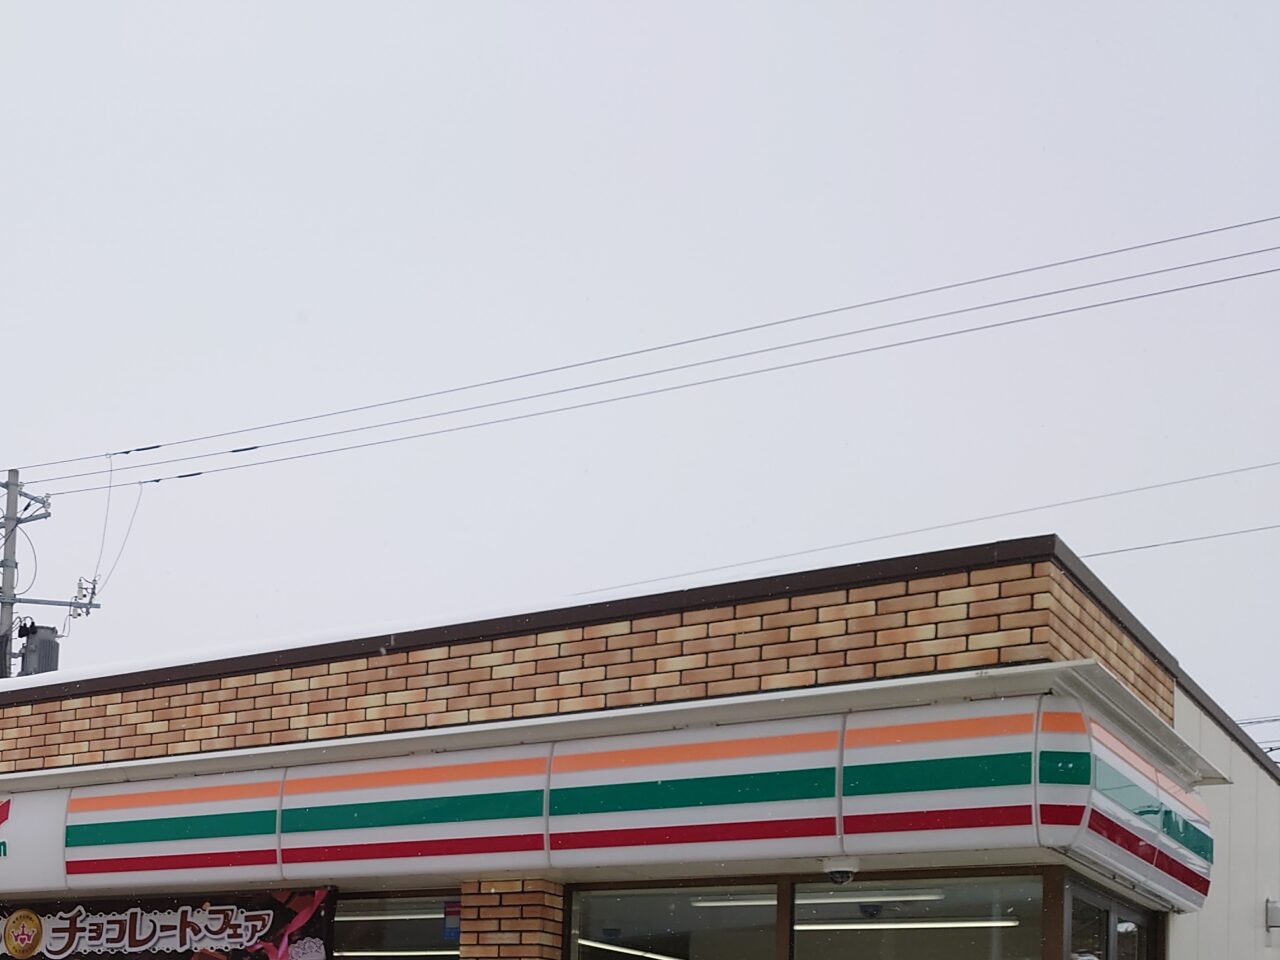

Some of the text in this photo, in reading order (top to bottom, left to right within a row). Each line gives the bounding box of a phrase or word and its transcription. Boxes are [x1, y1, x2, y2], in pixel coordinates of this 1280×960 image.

[50, 905, 273, 958] チョコレートフェア
